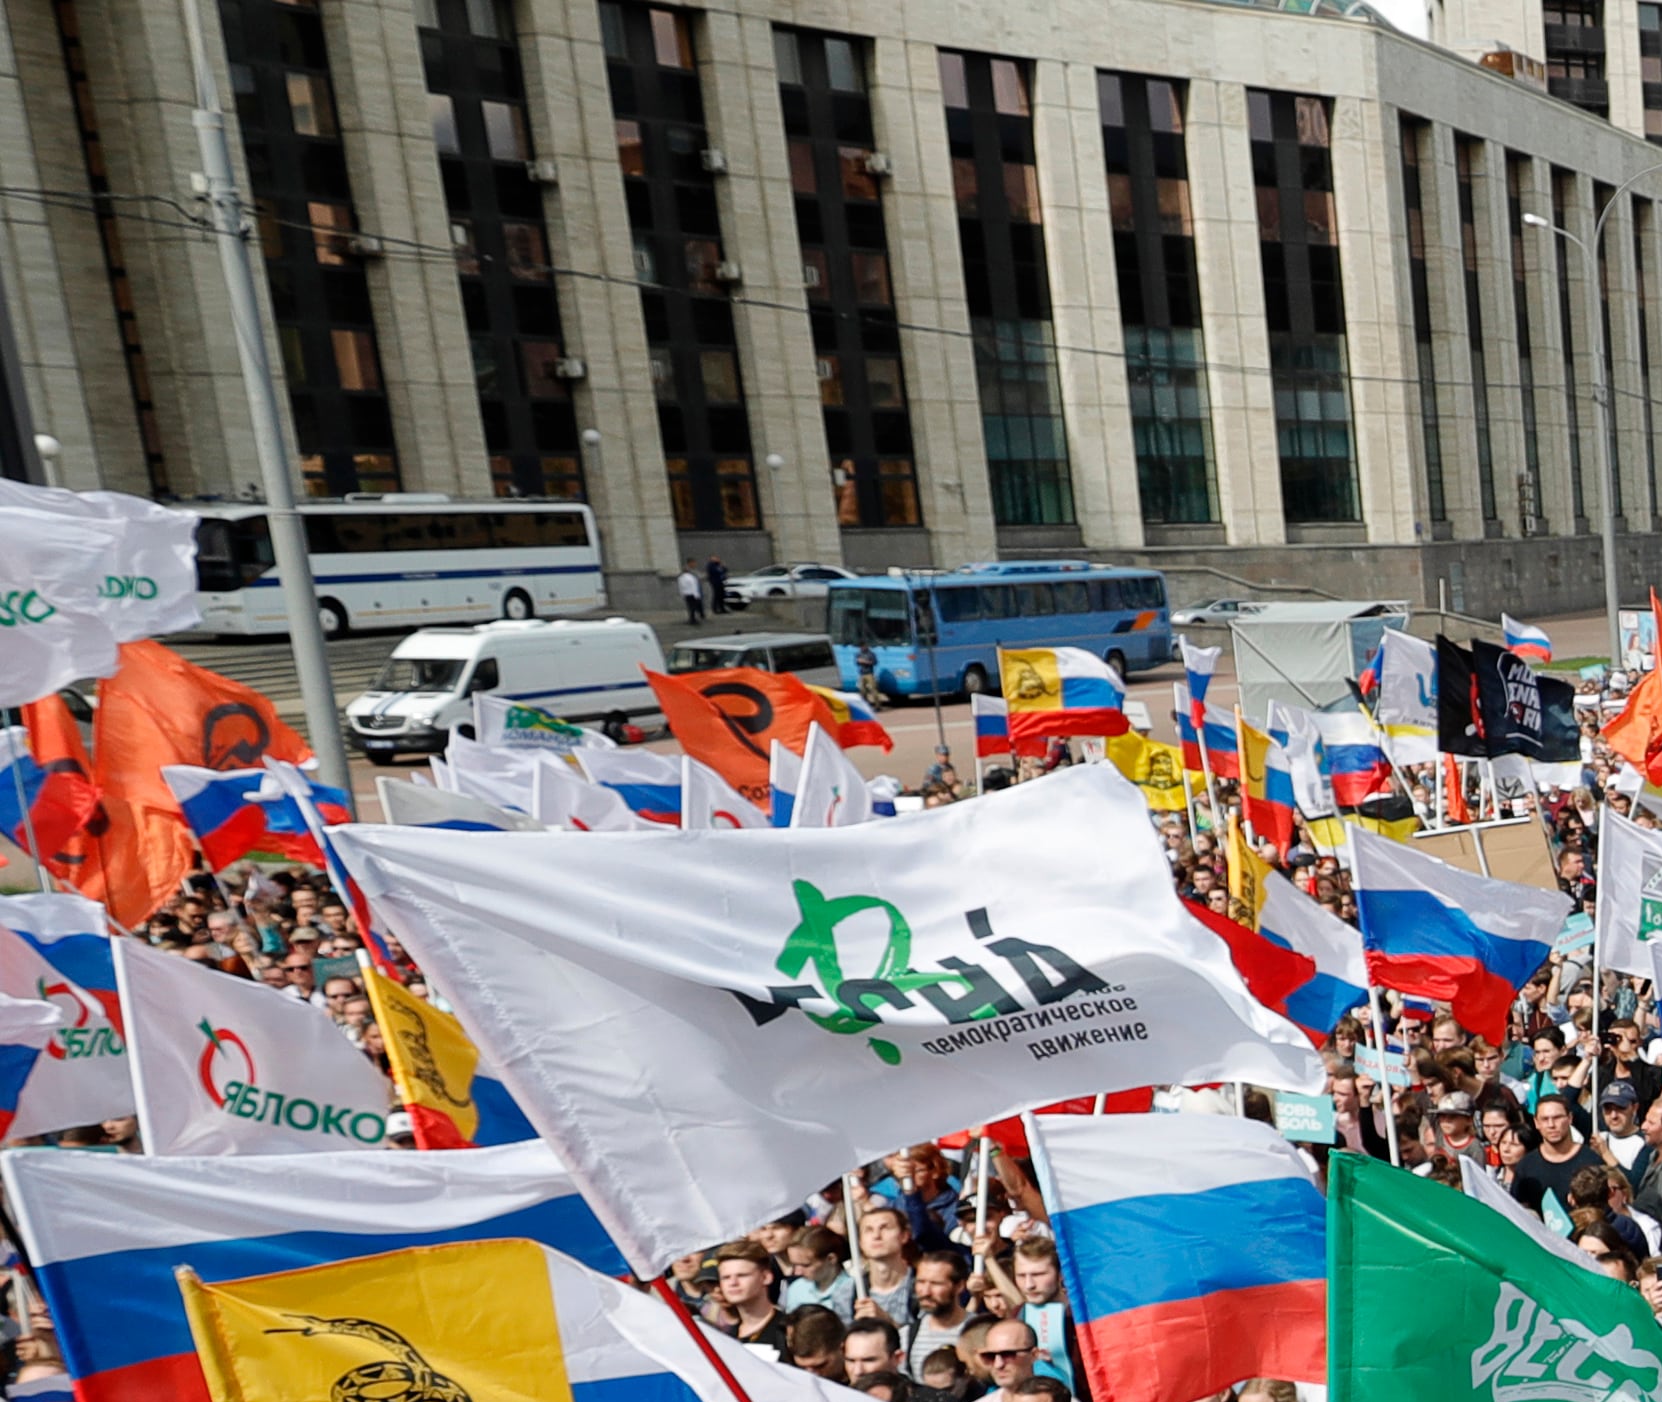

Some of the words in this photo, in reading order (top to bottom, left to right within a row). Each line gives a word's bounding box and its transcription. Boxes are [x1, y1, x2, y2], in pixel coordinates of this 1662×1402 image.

[921, 996, 1138, 1056] демократическое
[1027, 1023, 1149, 1061] движение
[223, 1081, 386, 1144] ЯБЛОКО
